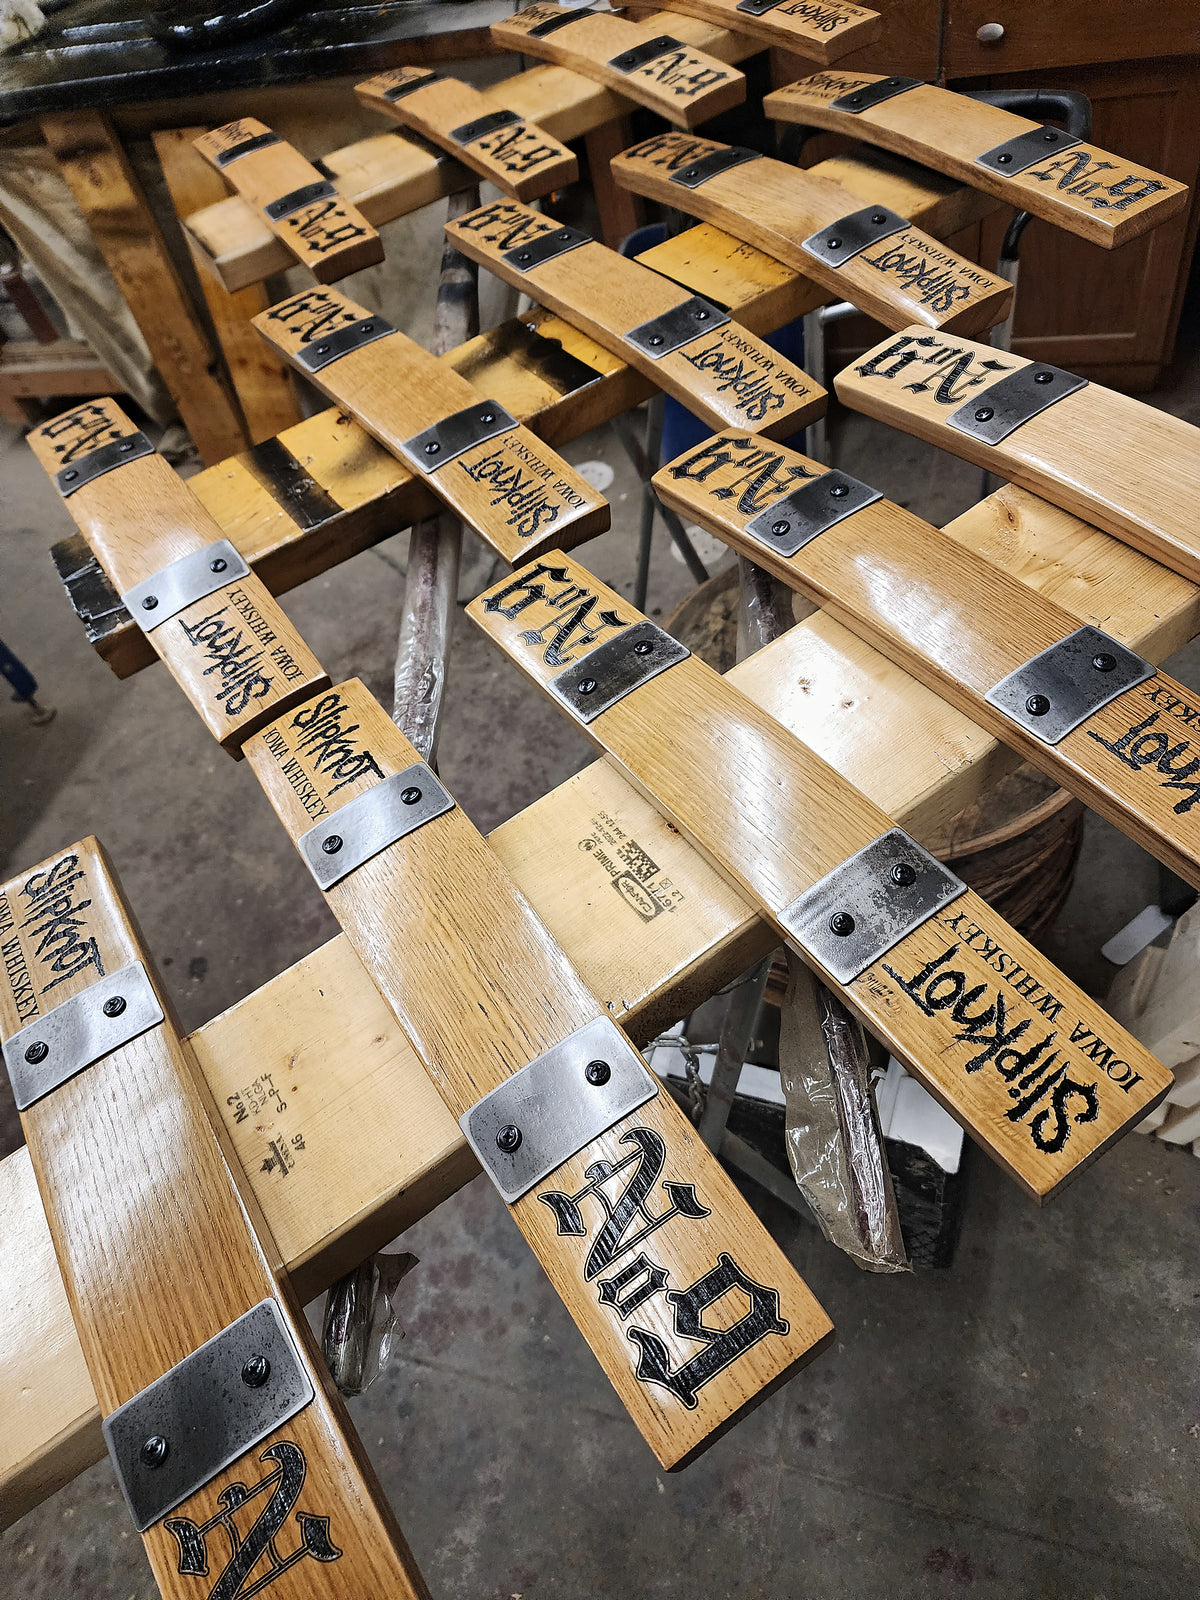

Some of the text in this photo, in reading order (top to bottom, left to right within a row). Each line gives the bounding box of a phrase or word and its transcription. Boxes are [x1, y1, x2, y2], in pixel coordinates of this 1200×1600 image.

[896, 233, 997, 289] IOWA WHISKEY
[716, 329, 811, 398] IOWA WHISKEY
[500, 435, 588, 510] IOWA WHISKEY
[226, 588, 305, 682] IOWA WHISKEY
[262, 726, 330, 822] IOWA WHISKEY
[593, 848, 621, 877] PRIME
[620, 879, 652, 913] CANFOR
[671, 889, 685, 902] L2
[1, 935, 40, 1023] WHISKEY
[943, 911, 1145, 1095] IOWA WHISKEY
[252, 1079, 268, 1106] NLGA
[291, 1133, 305, 1151] 46
